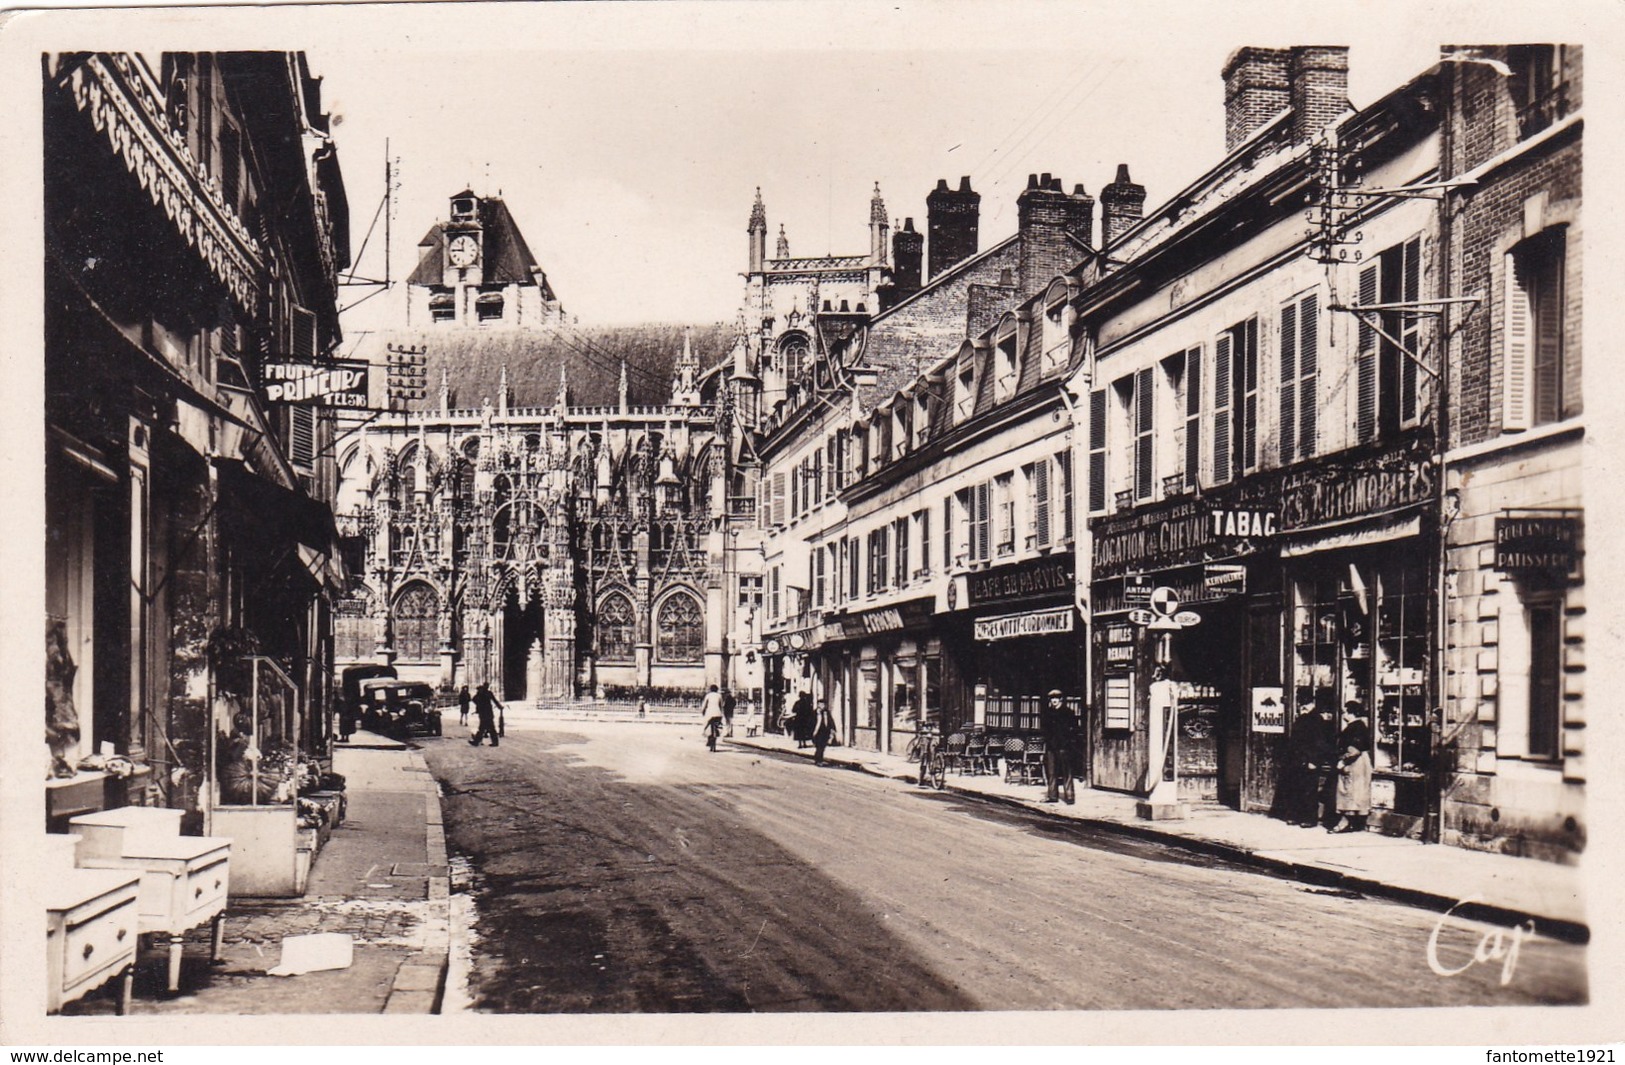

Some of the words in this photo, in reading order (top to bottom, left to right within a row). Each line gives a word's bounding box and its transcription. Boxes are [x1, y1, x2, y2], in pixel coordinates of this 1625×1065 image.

[265, 369, 365, 402] PRIMEURS
[1212, 510, 1276, 537] TABAC
[1093, 530, 1146, 567] LOCATION
[1160, 514, 1216, 553] CHEVAU
[1020, 565, 1066, 593] PARVIS
[1125, 586, 1152, 594] ANTAR
[1107, 646, 1134, 661] RENAULT
